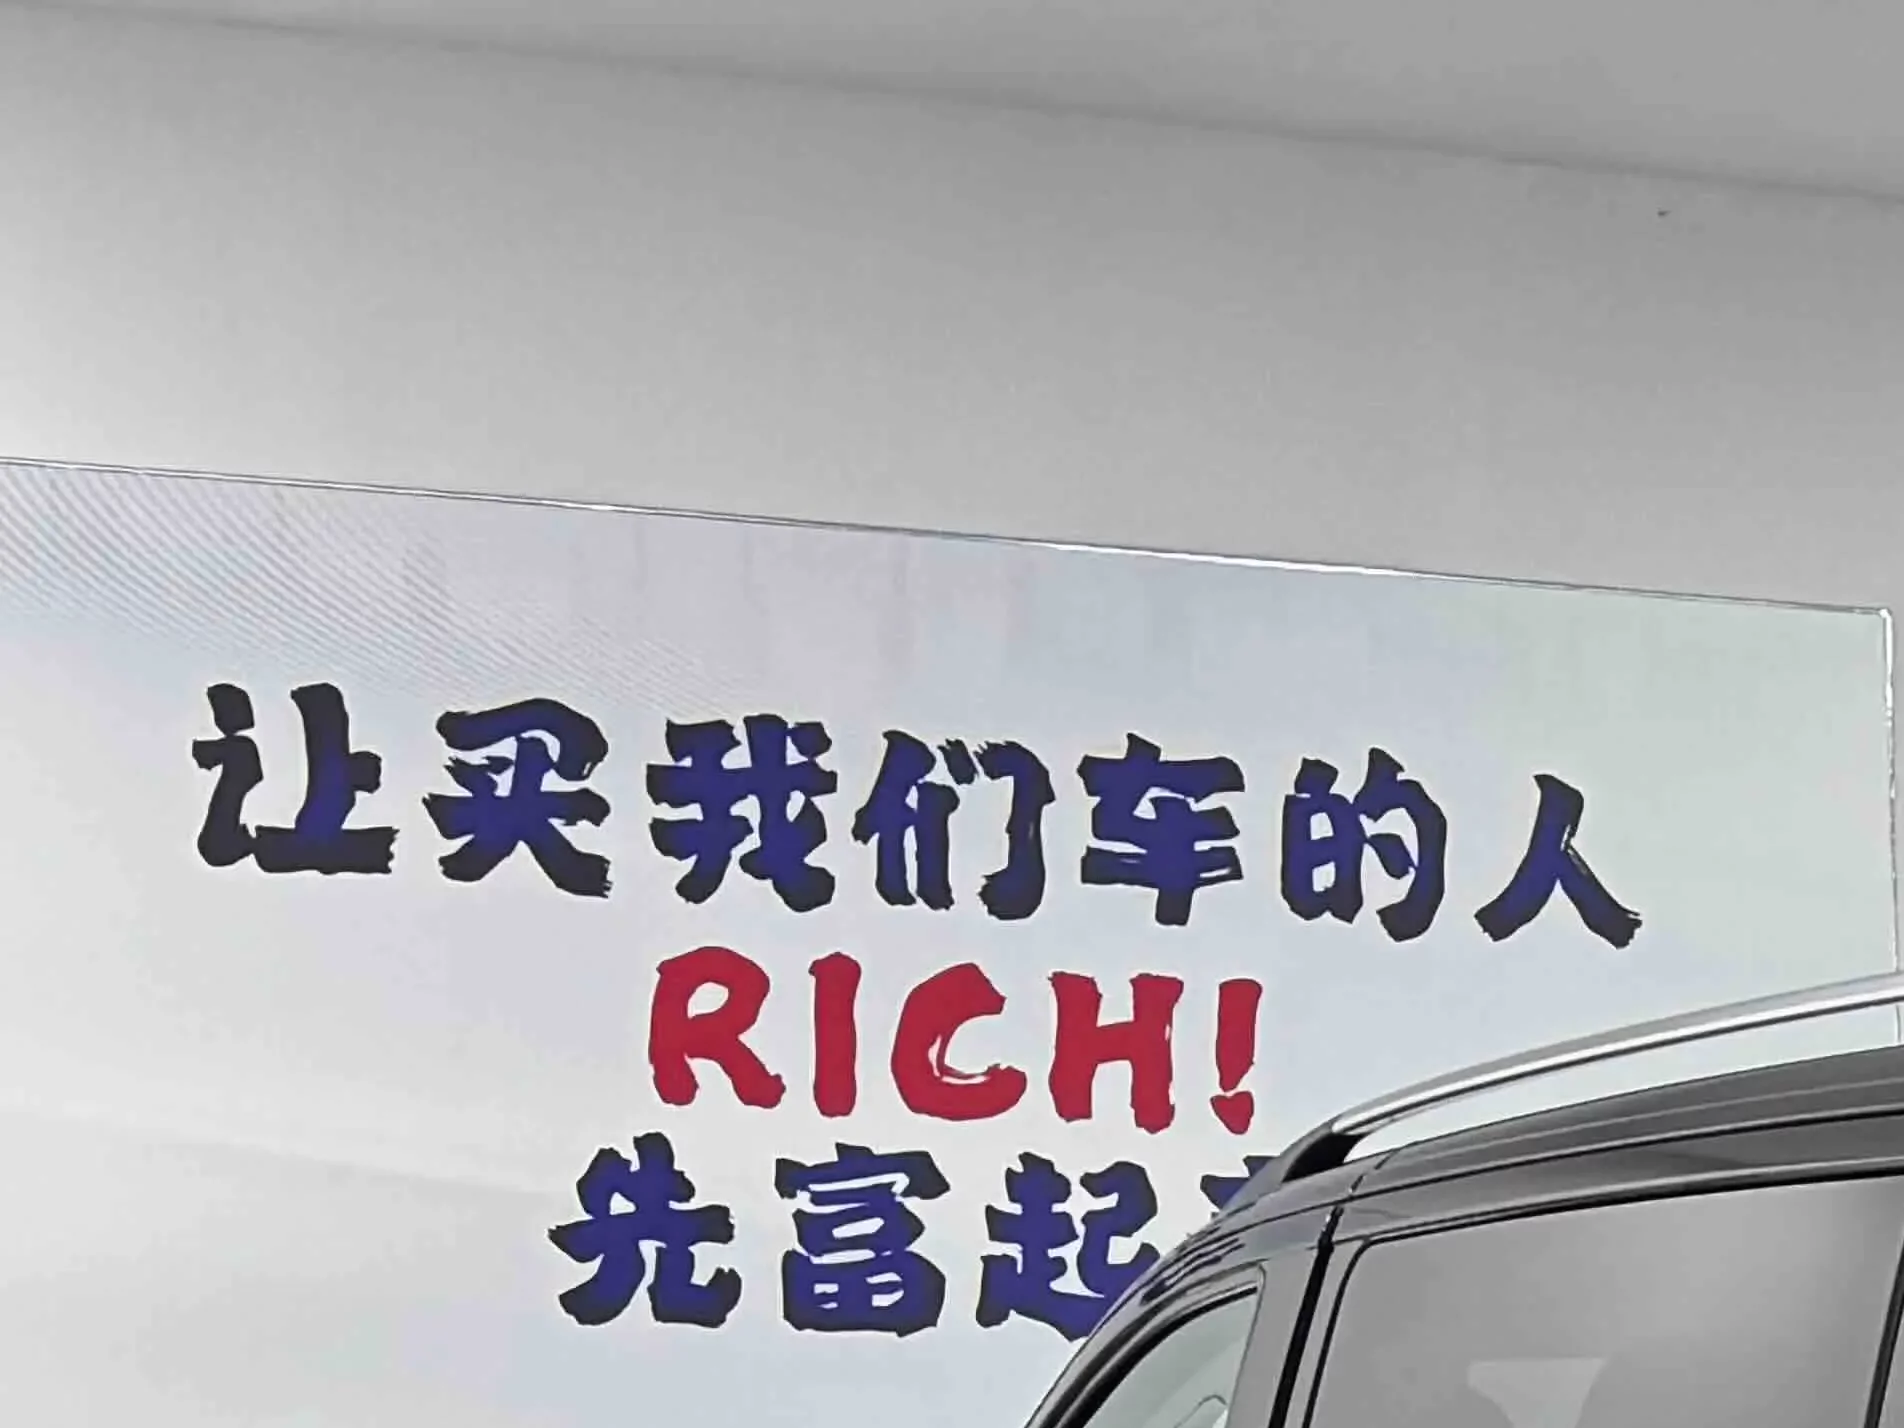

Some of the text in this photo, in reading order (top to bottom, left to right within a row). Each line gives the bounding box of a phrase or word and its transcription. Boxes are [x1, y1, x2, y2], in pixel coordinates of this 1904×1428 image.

[190, 681, 1644, 950] 让买我们车的人
[647, 945, 1264, 1135] RICH!
[550, 1132, 1282, 1342] 先富起
